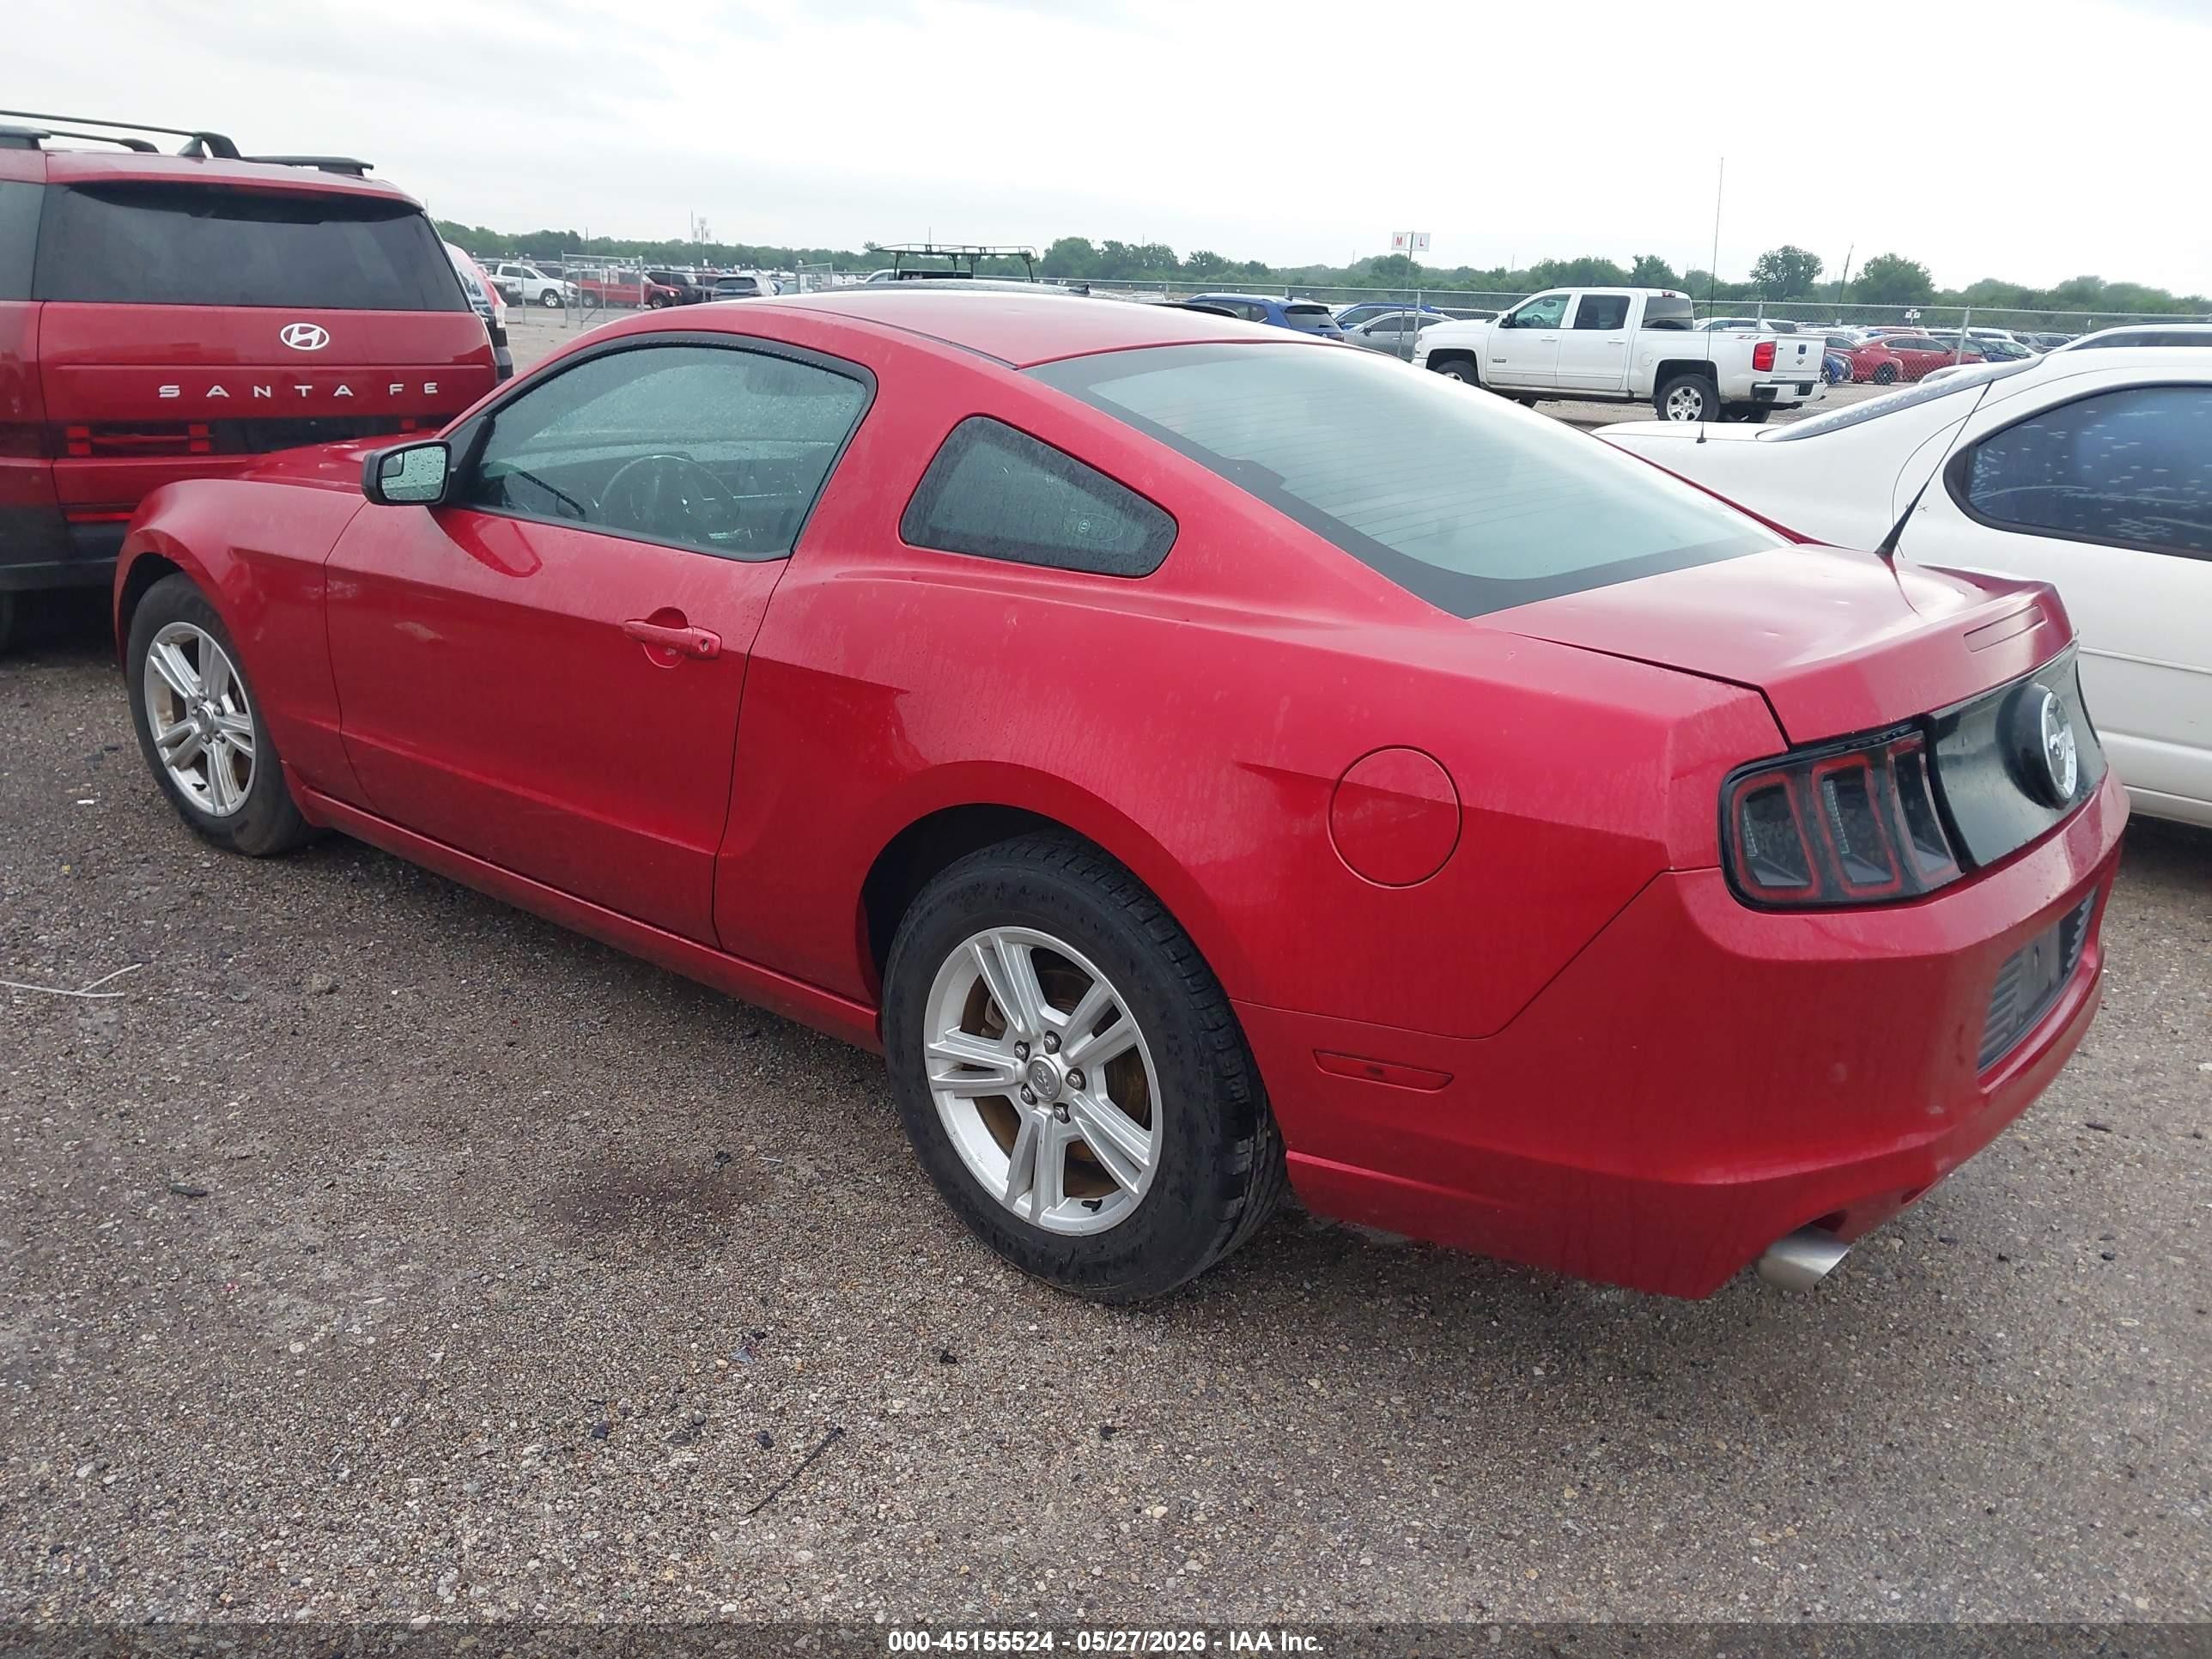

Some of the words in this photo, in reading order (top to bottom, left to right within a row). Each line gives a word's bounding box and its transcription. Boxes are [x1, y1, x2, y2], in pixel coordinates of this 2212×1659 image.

[1395, 236, 1403, 246] M
[158, 384, 355, 398] SANTA
[389, 382, 439, 396] FE
